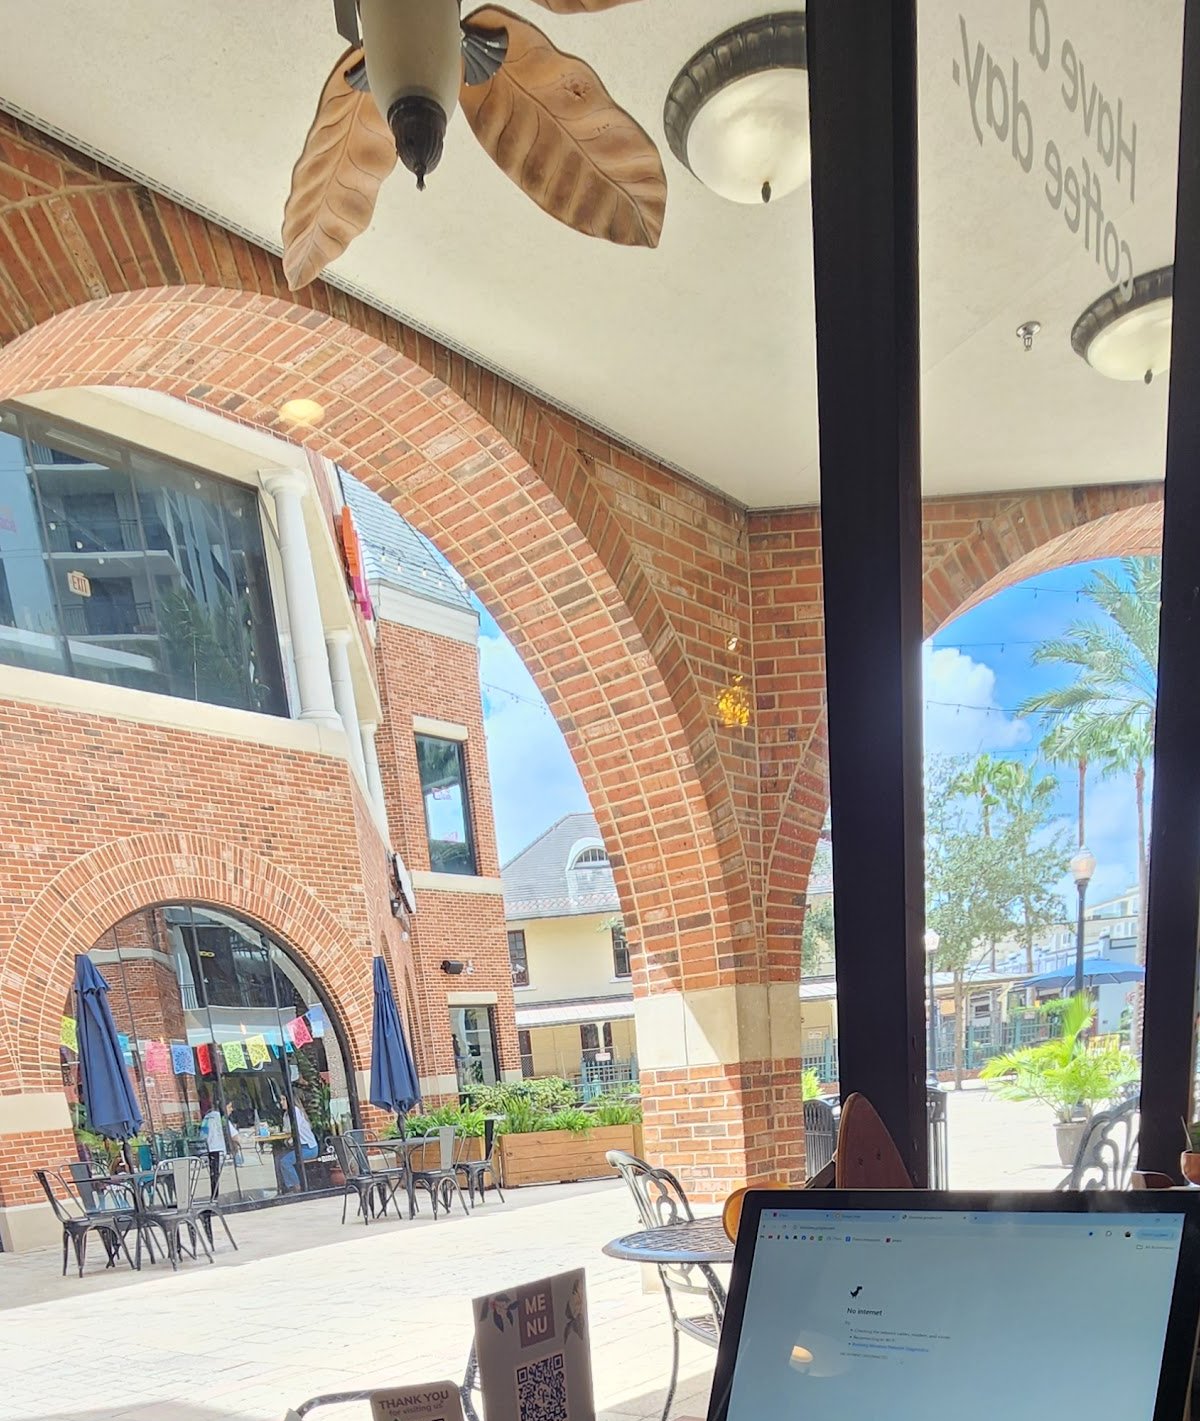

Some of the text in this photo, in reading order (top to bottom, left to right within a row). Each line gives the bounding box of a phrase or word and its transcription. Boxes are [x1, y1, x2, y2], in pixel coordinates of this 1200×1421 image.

[71, 575, 89, 594] EXIT
[525, 1294, 546, 1315] ME
[858, 1308, 883, 1316] internet
[526, 1316, 548, 1338] NU
[378, 1390, 449, 1410] THANK YOU
[403, 1404, 432, 1414] visiting
